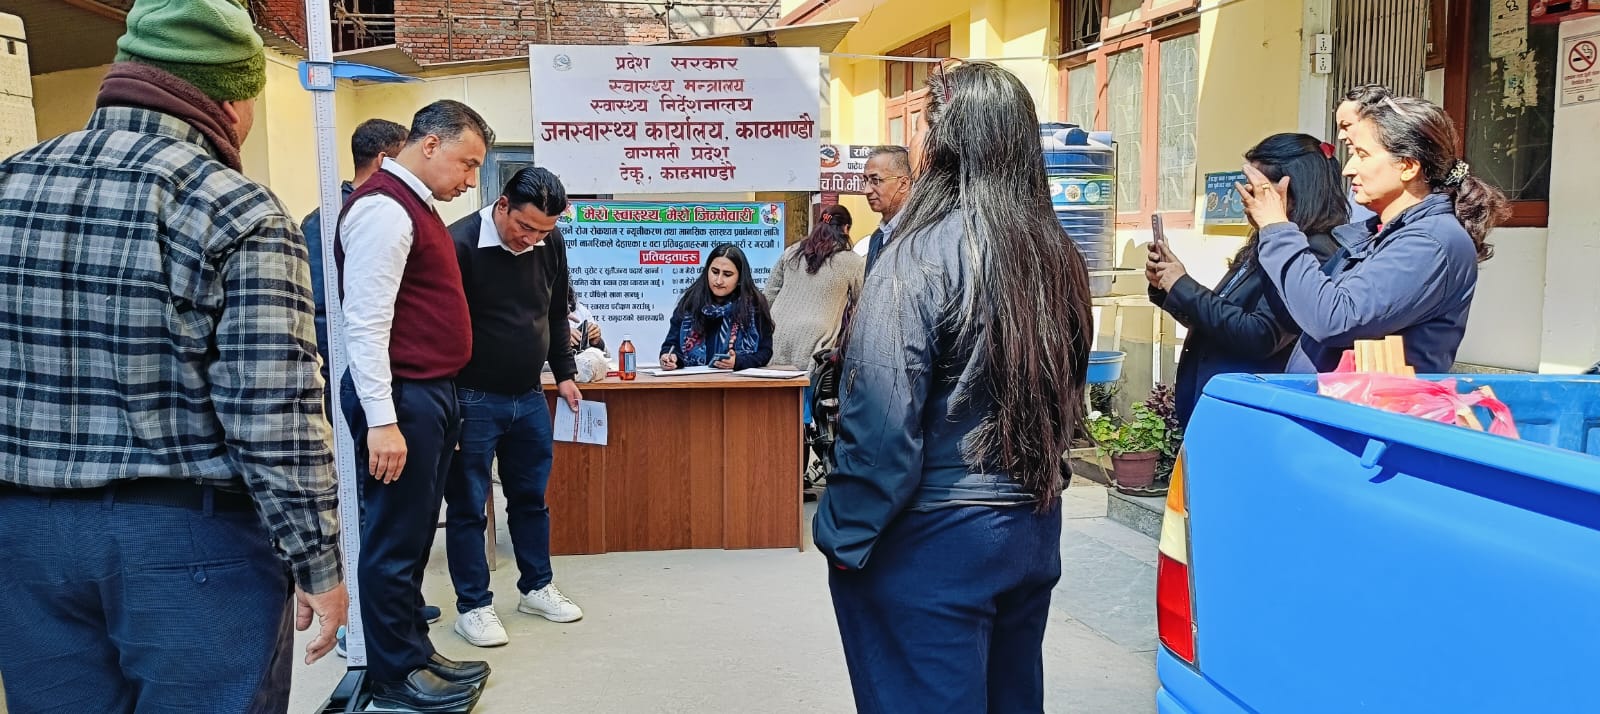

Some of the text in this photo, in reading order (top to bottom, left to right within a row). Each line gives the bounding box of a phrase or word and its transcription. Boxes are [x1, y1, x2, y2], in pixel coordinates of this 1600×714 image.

[615, 52, 738, 73] प्रदेश सरकार
[609, 79, 745, 94] स्वास्थ्य मन्त्रालय
[590, 94, 754, 114] स्वास्थ्य निर्देशनालय
[541, 121, 638, 142] जनस्वास्थ्य
[735, 112, 814, 140] काठमाण्डौ
[691, 142, 730, 161] प्रदेश
[583, 206, 609, 220] मेरो
[666, 206, 690, 221] मेरो
